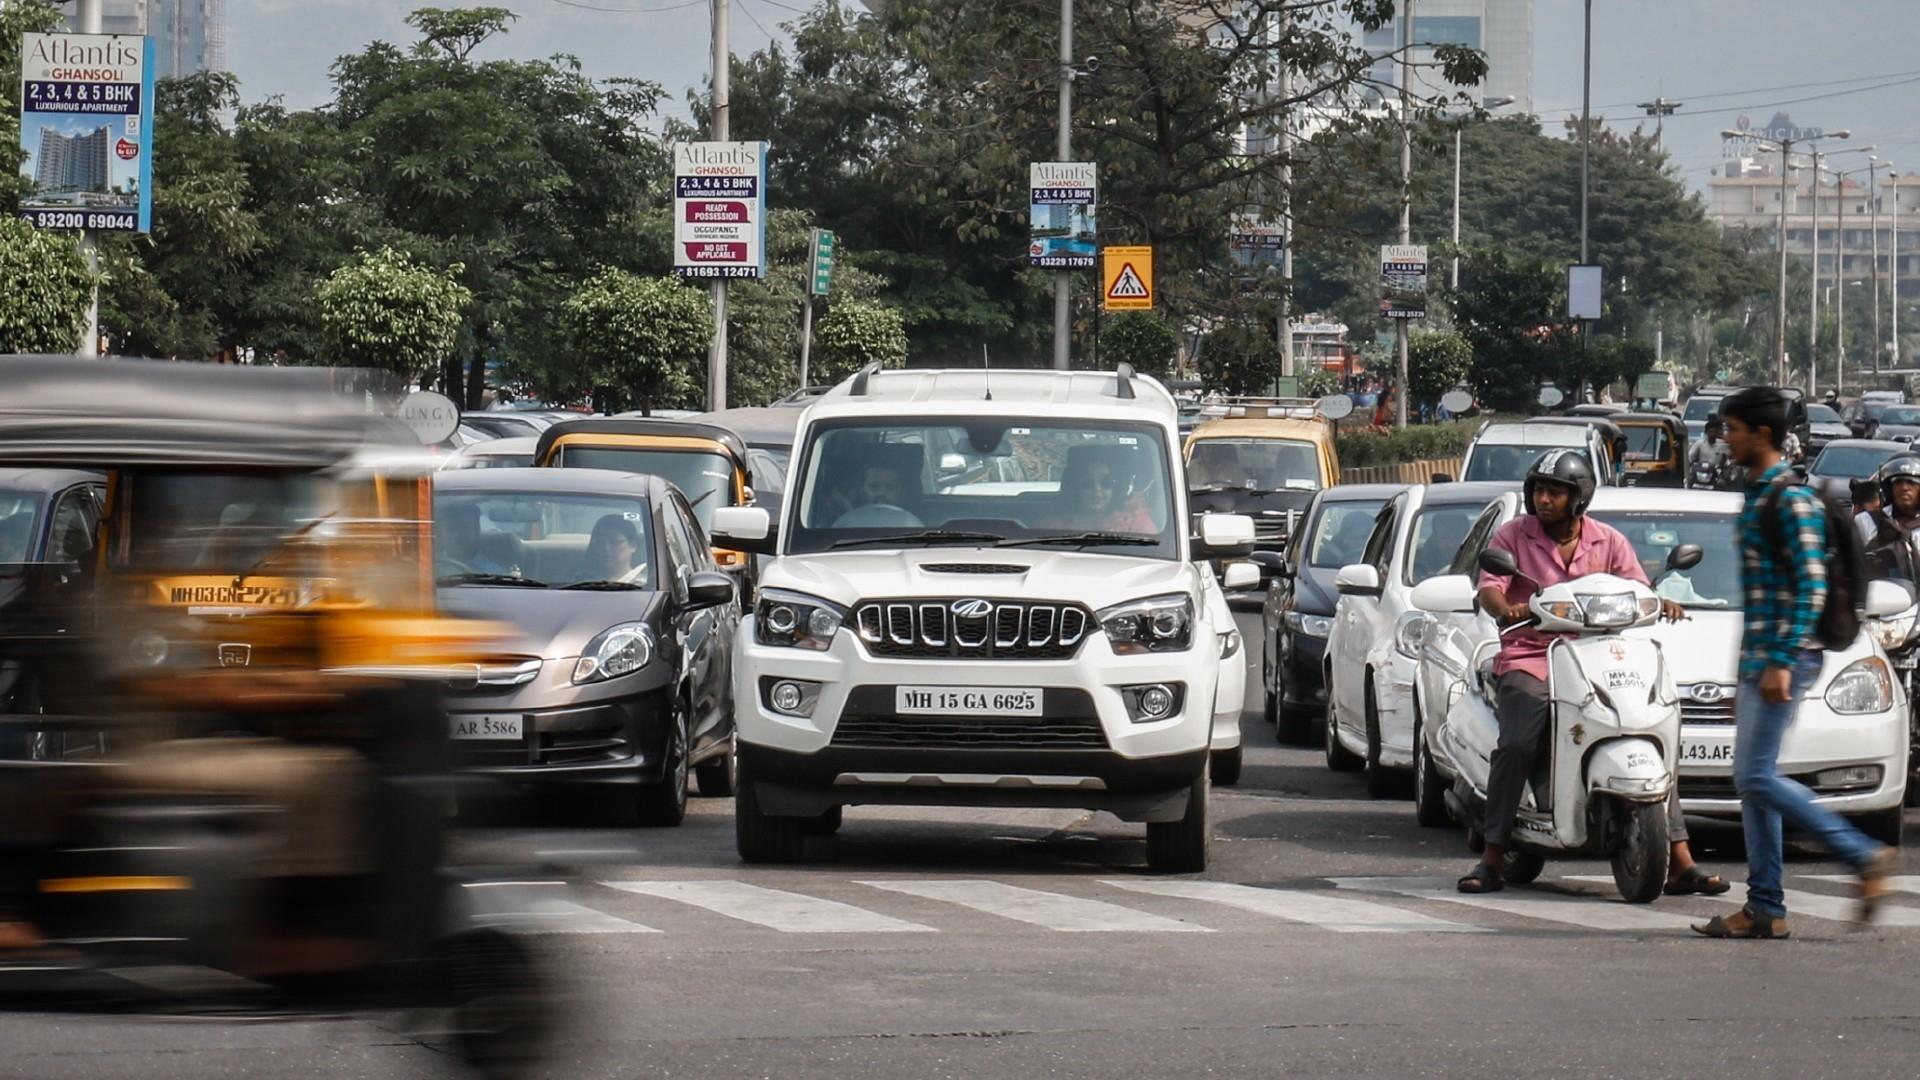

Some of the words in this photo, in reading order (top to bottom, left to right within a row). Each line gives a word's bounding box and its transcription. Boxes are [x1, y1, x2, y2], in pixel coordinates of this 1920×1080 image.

[28, 38, 138, 66] Atlantis
[51, 67, 124, 81] GHANSOLI
[30, 83, 43, 101] 2,
[47, 83, 60, 101] 3,
[64, 85, 73, 100] 4
[77, 85, 88, 100] &
[92, 85, 101, 101] 5
[104, 85, 134, 102] BHK
[35, 101, 80, 112] LUXURIOUS
[81, 102, 128, 113] APARTMENT
[679, 145, 756, 165] Atlantis
[695, 166, 745, 175] GHANSOLI
[1036, 165, 1094, 180] Atlantis
[703, 178, 711, 188] 4
[713, 178, 721, 188] &
[723, 178, 730, 188] 5
[732, 178, 754, 189] BHK
[1045, 180, 1086, 188] GHANSOLI
[1052, 189, 1058, 199] 4
[1060, 189, 1067, 199] &
[1068, 189, 1074, 199] 5
[1074, 189, 1092, 200] BHK
[705, 203, 728, 212] READY
[38, 212, 84, 228] 93200
[88, 213, 134, 229] 69044
[695, 211, 739, 221] POSSESSION
[694, 226, 739, 234] OCCUPANCY
[696, 251, 737, 260] APPLICABLE
[1040, 257, 1067, 267] 93229
[686, 267, 720, 278] 81693
[723, 267, 757, 278] 12471
[405, 407, 454, 420] UNGA
[904, 692, 933, 709] MH
[938, 693, 958, 709] 15
[963, 693, 988, 709] GA
[993, 694, 1036, 710] 6625
[456, 721, 478, 735] AR
[483, 720, 517, 735] 5586
